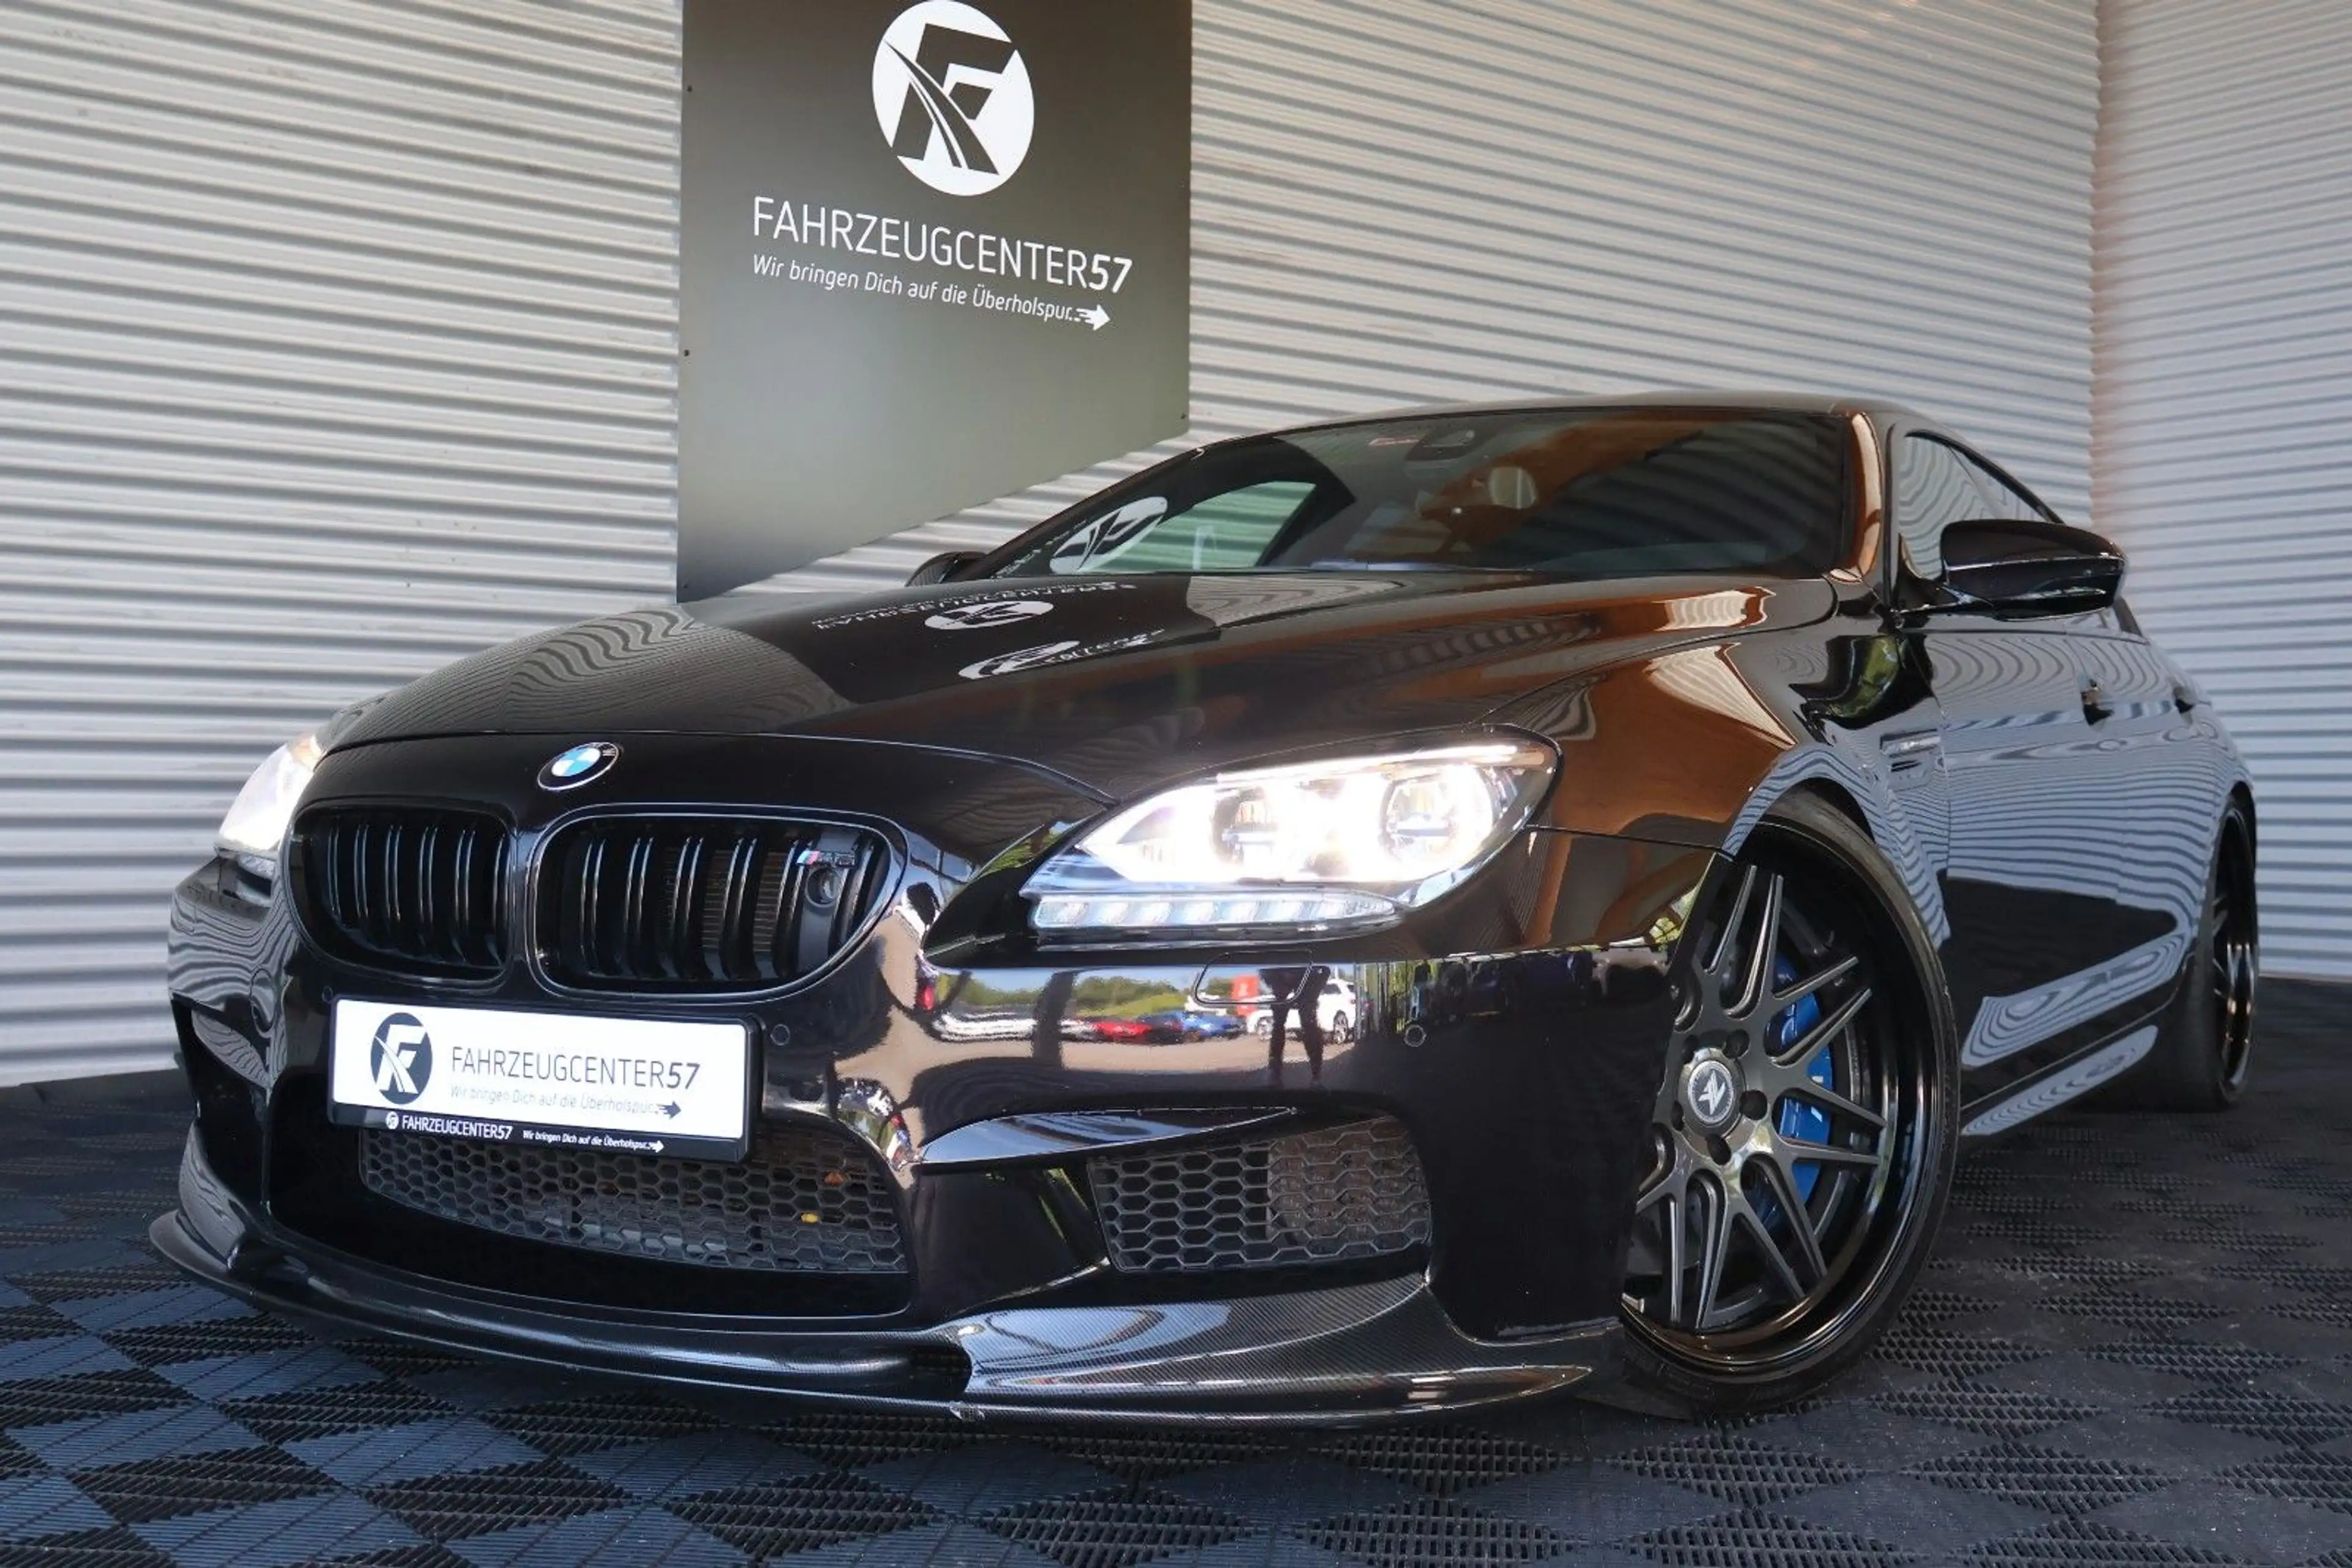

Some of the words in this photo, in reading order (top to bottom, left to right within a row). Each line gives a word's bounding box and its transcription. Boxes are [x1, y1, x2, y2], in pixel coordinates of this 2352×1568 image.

[753, 196, 1133, 294] FAHRZEUGCENTER57
[753, 254, 785, 277] Wir
[789, 259, 859, 291] bringen
[864, 271, 903, 295] Dich
[907, 281, 940, 301] auf
[941, 284, 967, 305] die
[452, 1046, 701, 1090] FAHRZEUGCENTER57
[451, 1084, 467, 1099] Wir
[512, 1088, 536, 1104] Dich
[539, 1093, 557, 1106] auf
[560, 1093, 577, 1108] die
[401, 1115, 514, 1140] FAHRZEUGCENTER57
[522, 1130, 535, 1140] Wir
[535, 1132, 561, 1144] bringen
[562, 1133, 577, 1144] Dich
[578, 1135, 590, 1145] auf
[590, 1136, 603, 1146] die
